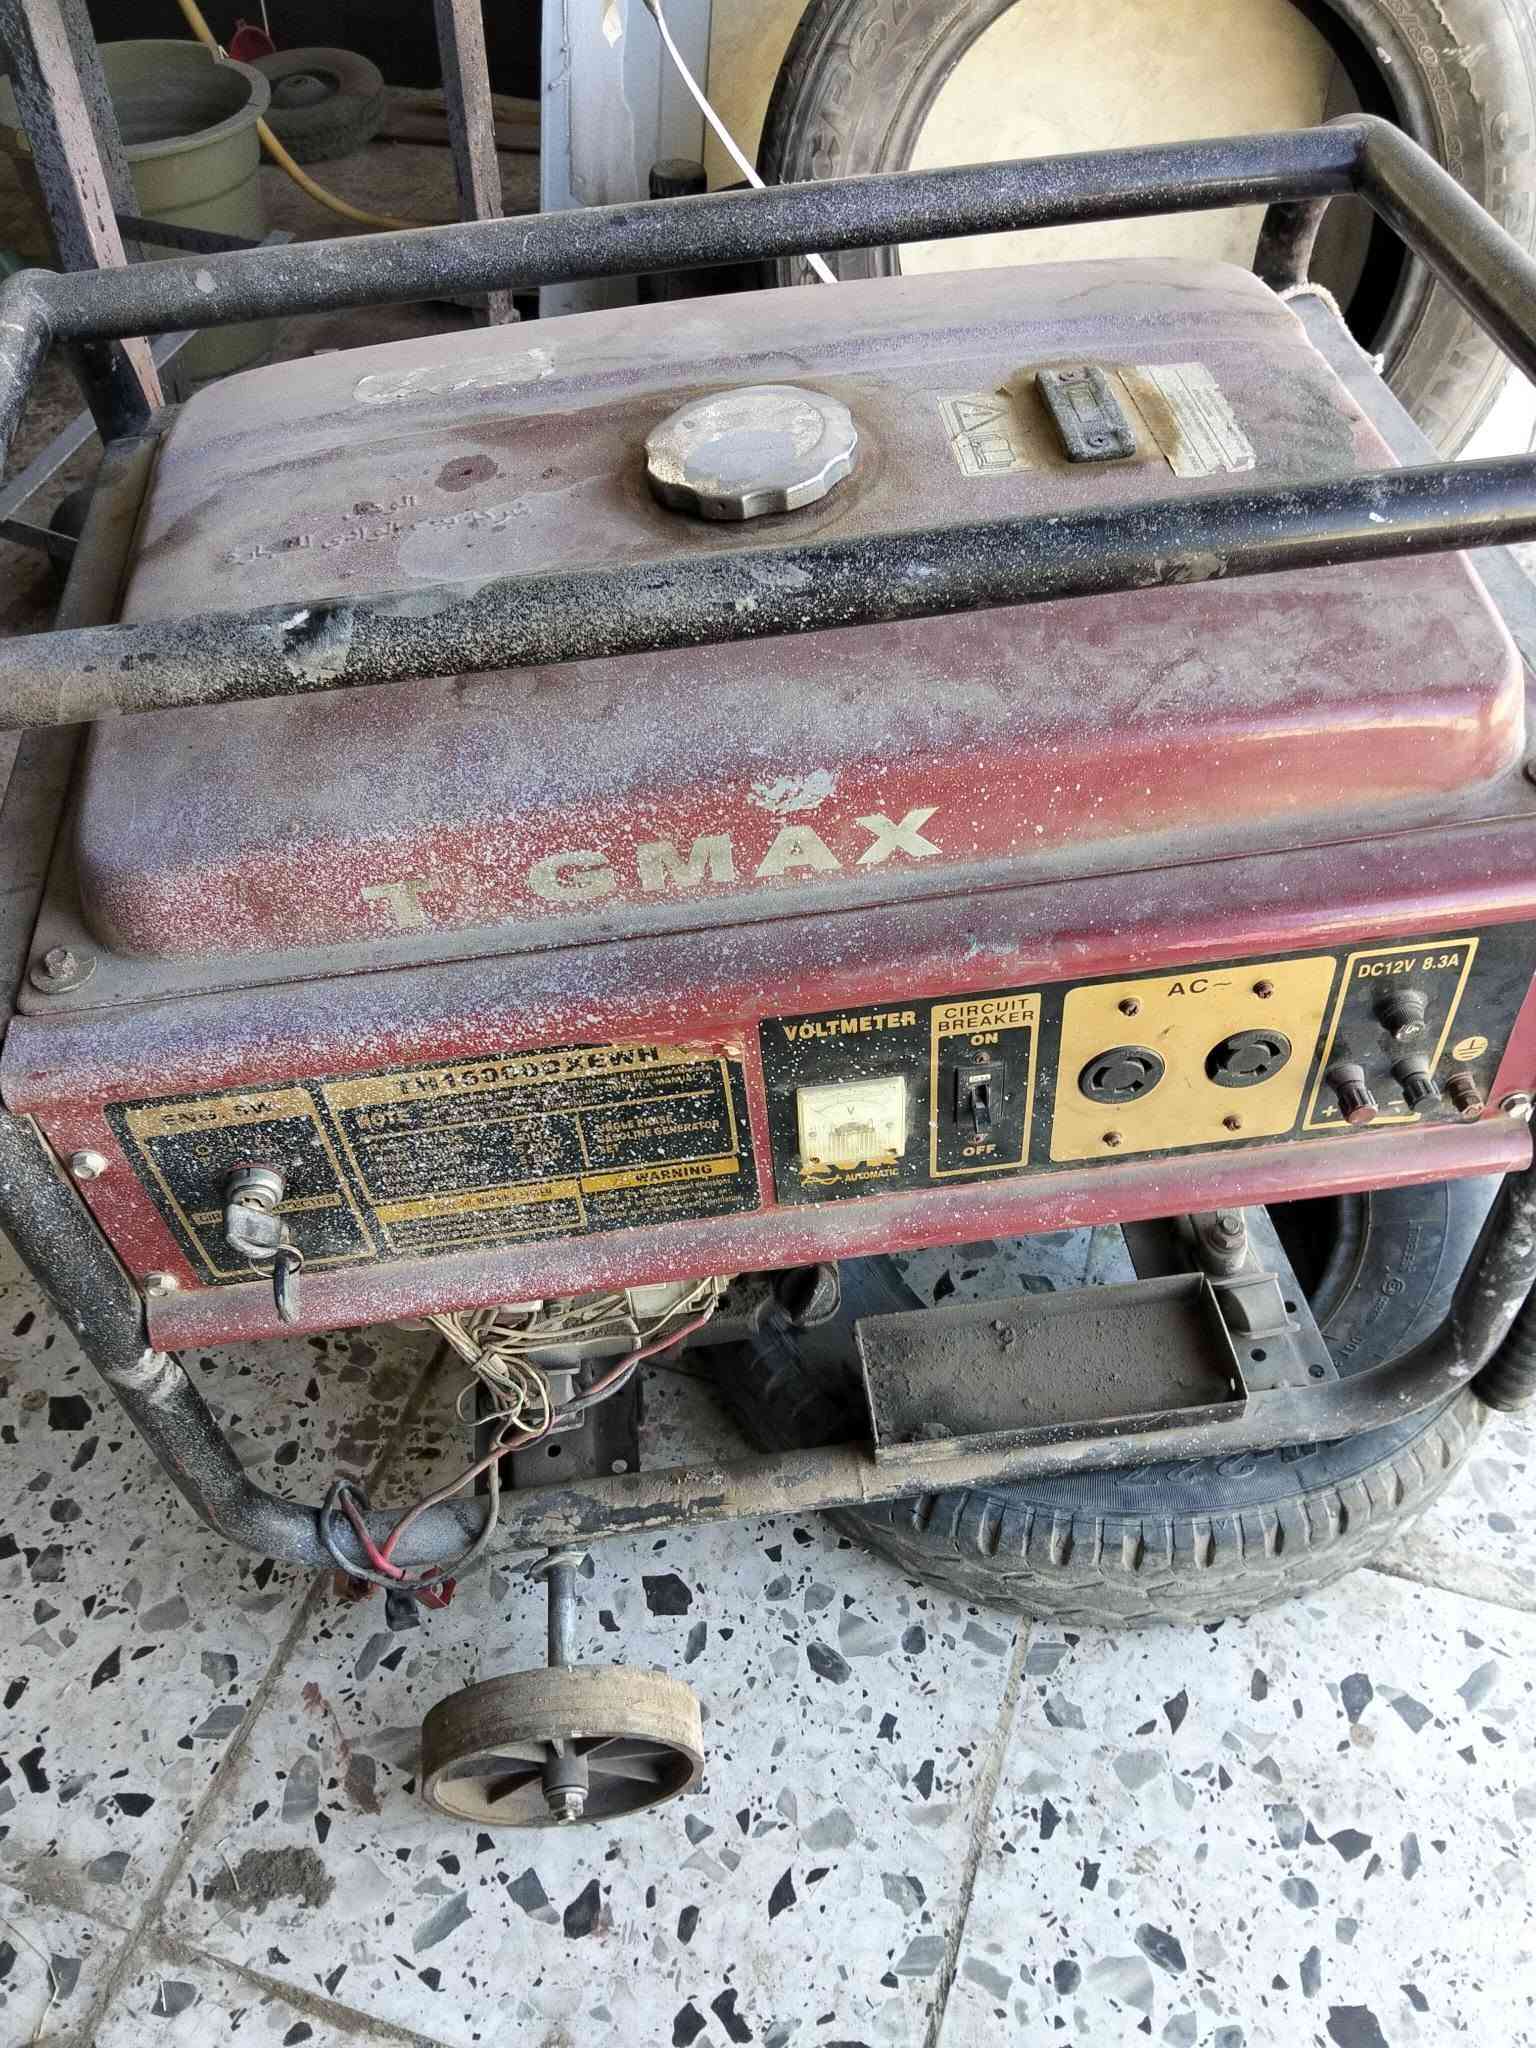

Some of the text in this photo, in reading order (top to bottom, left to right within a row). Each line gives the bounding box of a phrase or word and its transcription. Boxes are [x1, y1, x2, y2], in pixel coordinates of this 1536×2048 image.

[1357, 952, 1461, 979] DC12V 8.3A
[943, 998, 1030, 1019] CIRCUIT
[784, 1010, 917, 1042] VOLTMETER
[938, 1010, 1034, 1032] BREAKER
[970, 1032, 999, 1047] ON
[847, 1105, 855, 1115] V
[597, 1119, 721, 1145] GASOLINE GENERATOR
[636, 1114, 675, 1129] PHASE
[961, 1143, 997, 1158] OFF
[634, 1162, 713, 1184] WARNING
[844, 1167, 900, 1182] AUTOMATIC
